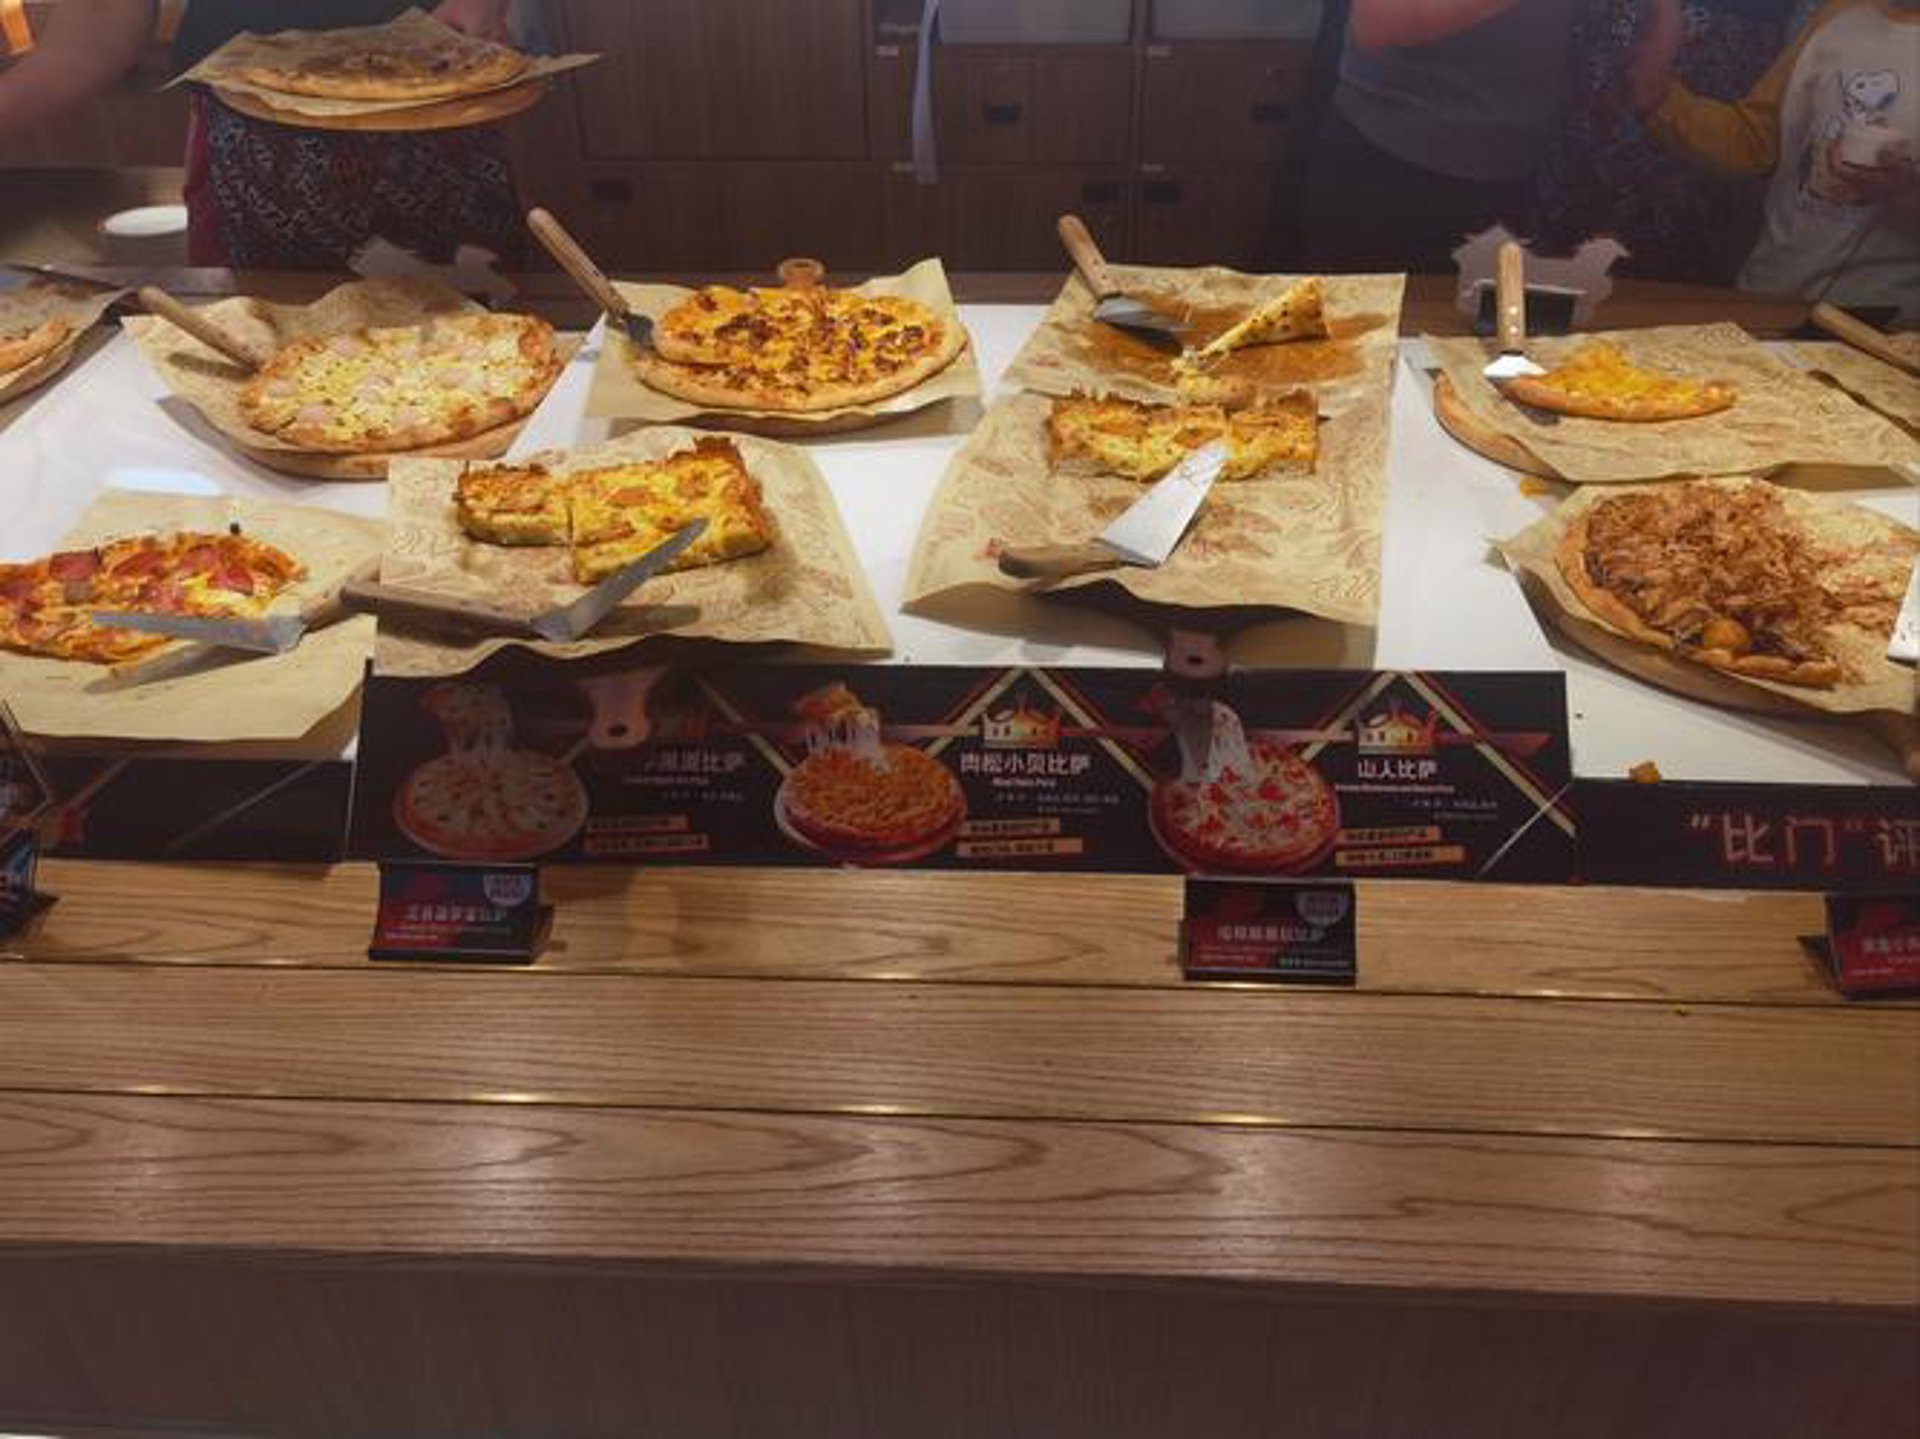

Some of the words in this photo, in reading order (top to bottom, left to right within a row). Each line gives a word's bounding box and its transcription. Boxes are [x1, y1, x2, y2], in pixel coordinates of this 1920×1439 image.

[961, 752, 1090, 775] 肉松小贝比萨
[1357, 759, 1438, 779] 山人比萨
